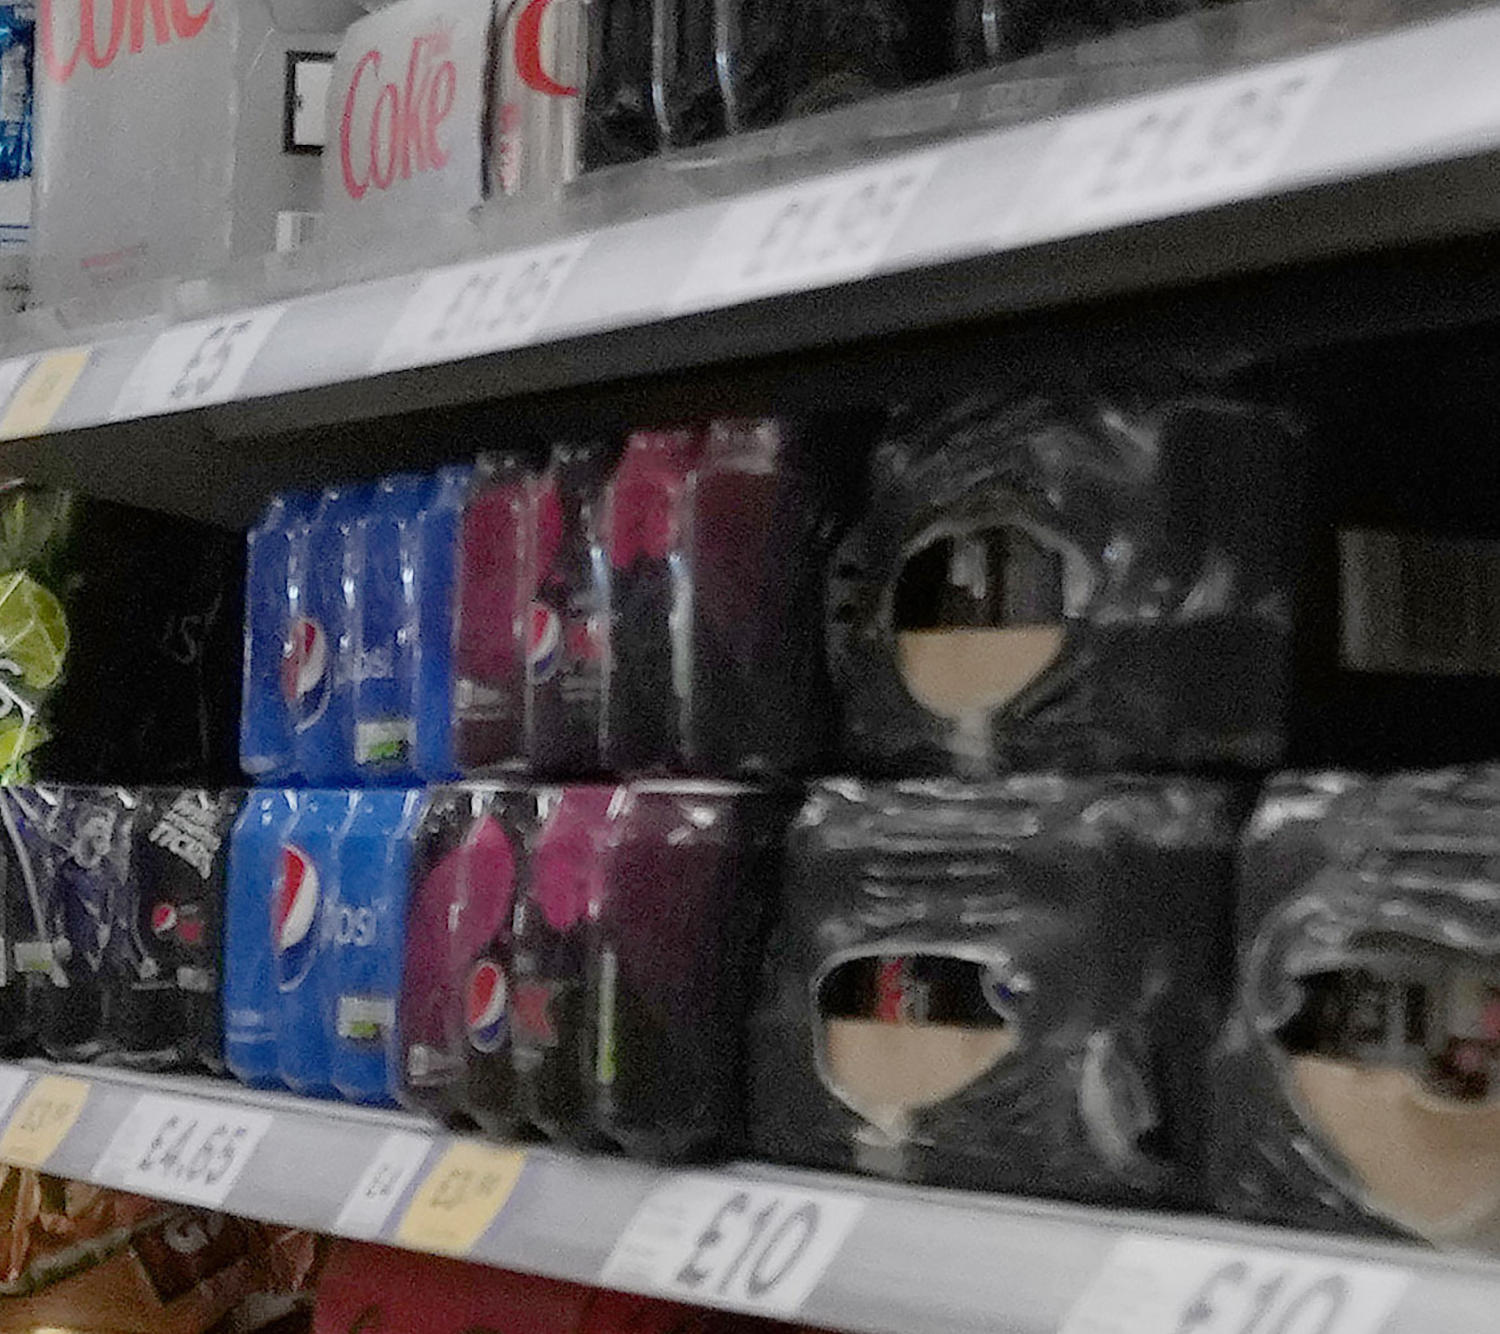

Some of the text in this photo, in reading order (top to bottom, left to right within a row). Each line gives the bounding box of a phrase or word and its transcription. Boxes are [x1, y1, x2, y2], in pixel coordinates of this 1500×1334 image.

[339, 28, 457, 202] Coke
[136, 1113, 249, 1187] £4.65
[675, 1189, 820, 1297] £10
